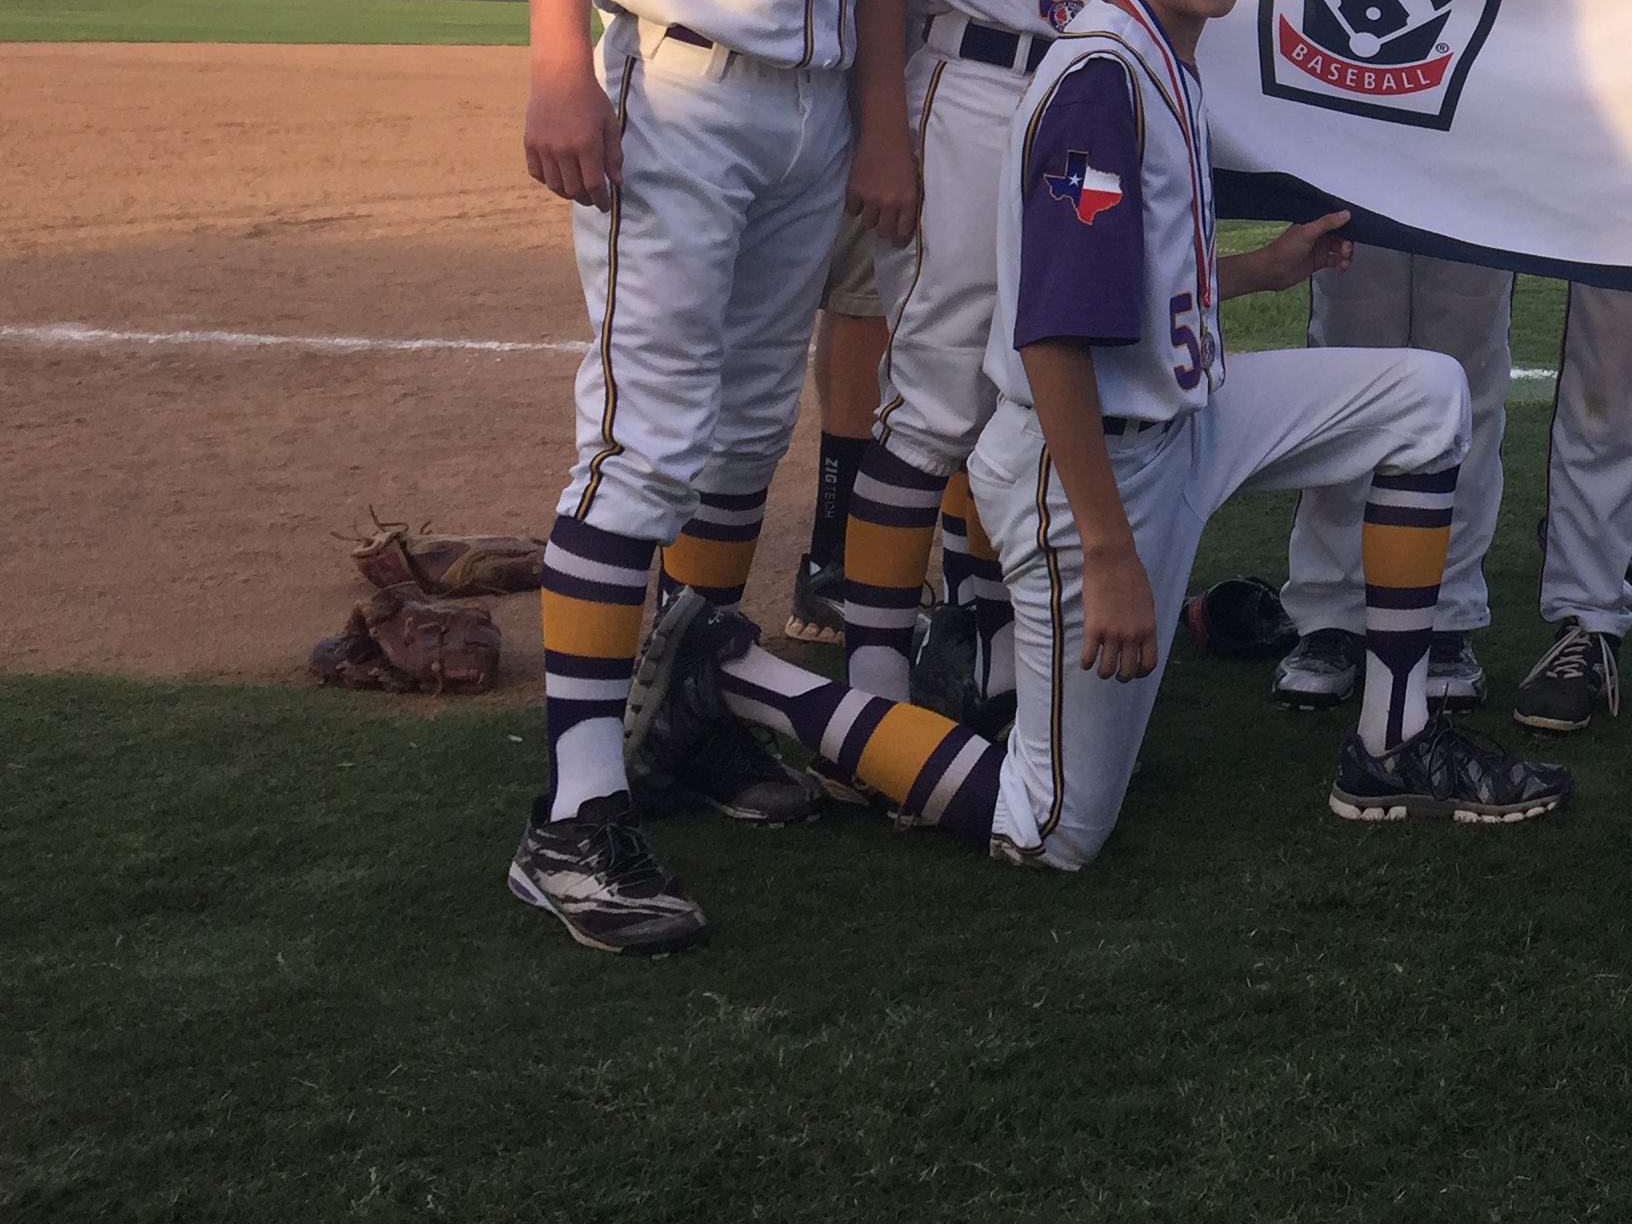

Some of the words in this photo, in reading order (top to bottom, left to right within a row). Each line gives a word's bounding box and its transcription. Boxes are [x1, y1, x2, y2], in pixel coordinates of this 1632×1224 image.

[1291, 42, 1431, 90] BASEBALL
[1169, 291, 1201, 391] 5
[824, 457, 839, 519] ZIGTECH
